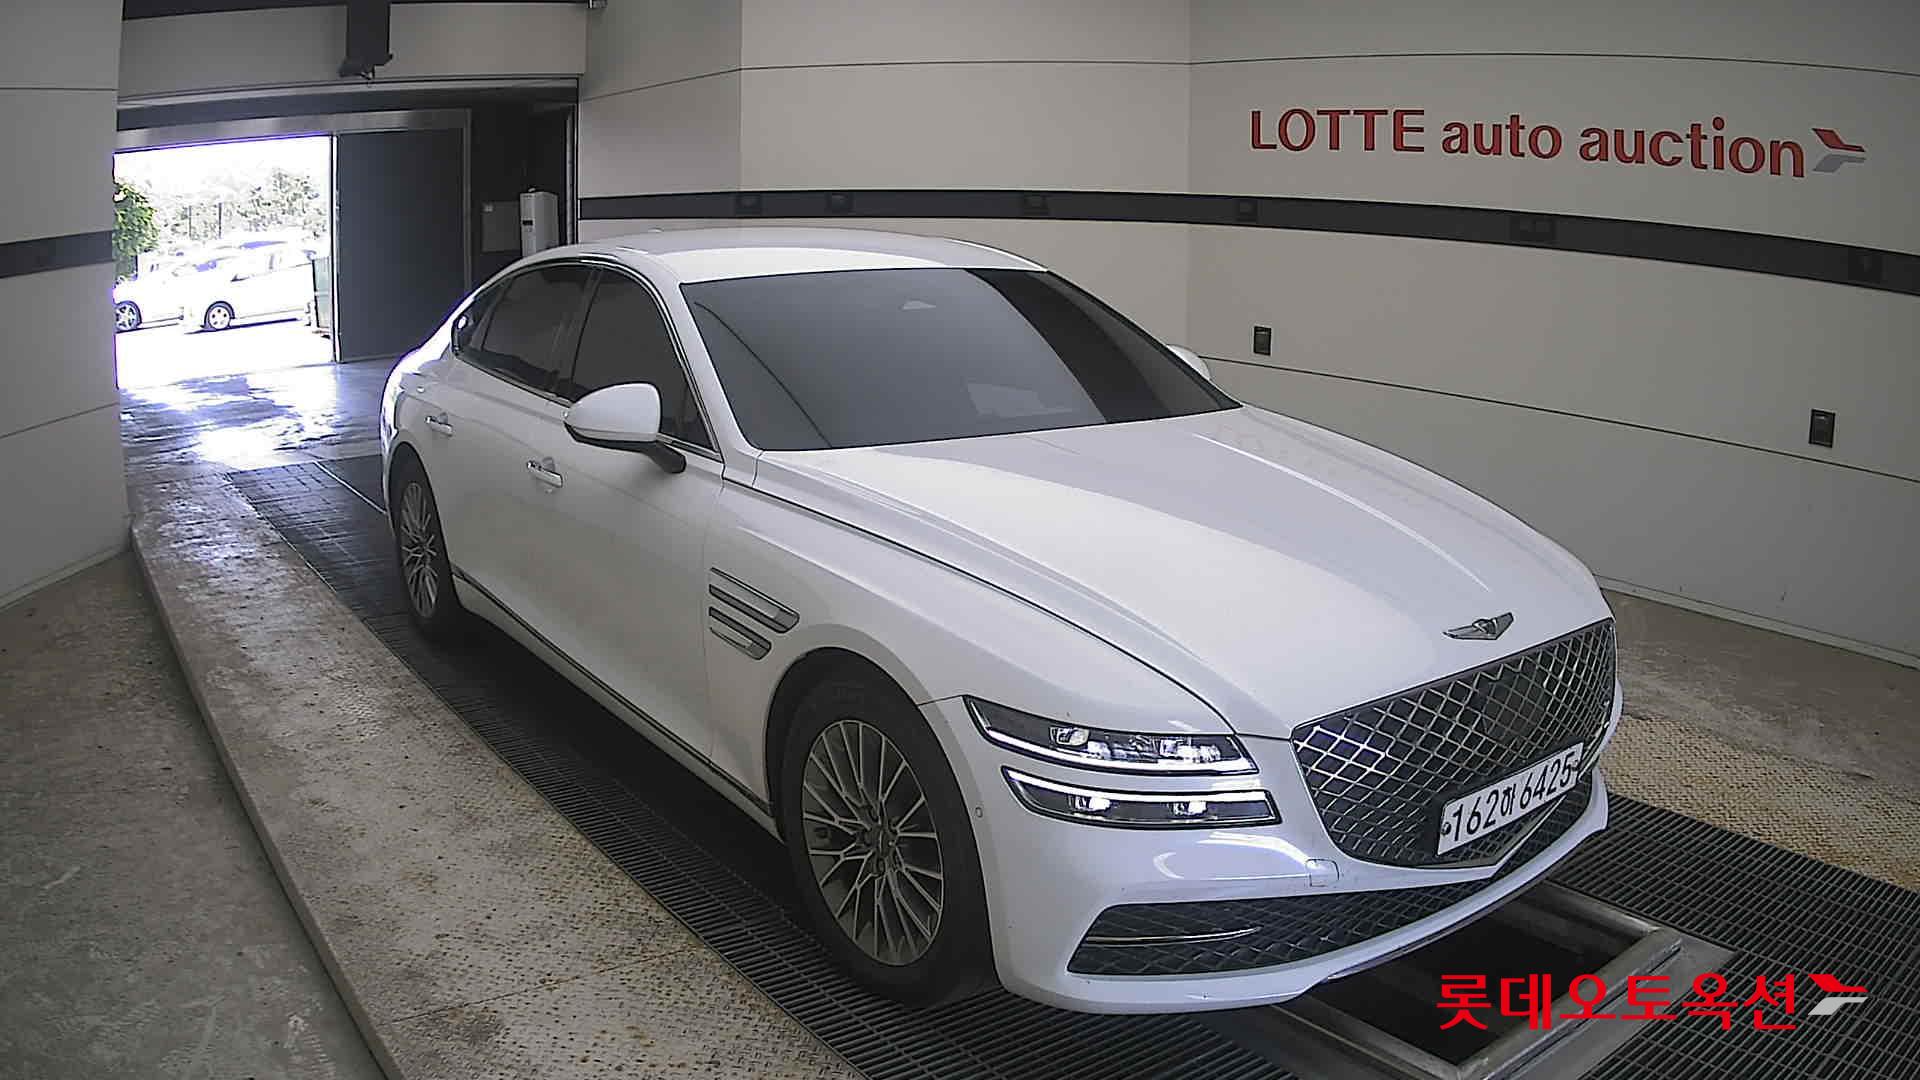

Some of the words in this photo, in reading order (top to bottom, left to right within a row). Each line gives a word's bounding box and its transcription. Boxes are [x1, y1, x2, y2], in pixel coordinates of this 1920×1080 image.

[1251, 109, 1425, 151] LOTTE
[1441, 114, 1562, 159] auto
[1579, 116, 1805, 178] auction
